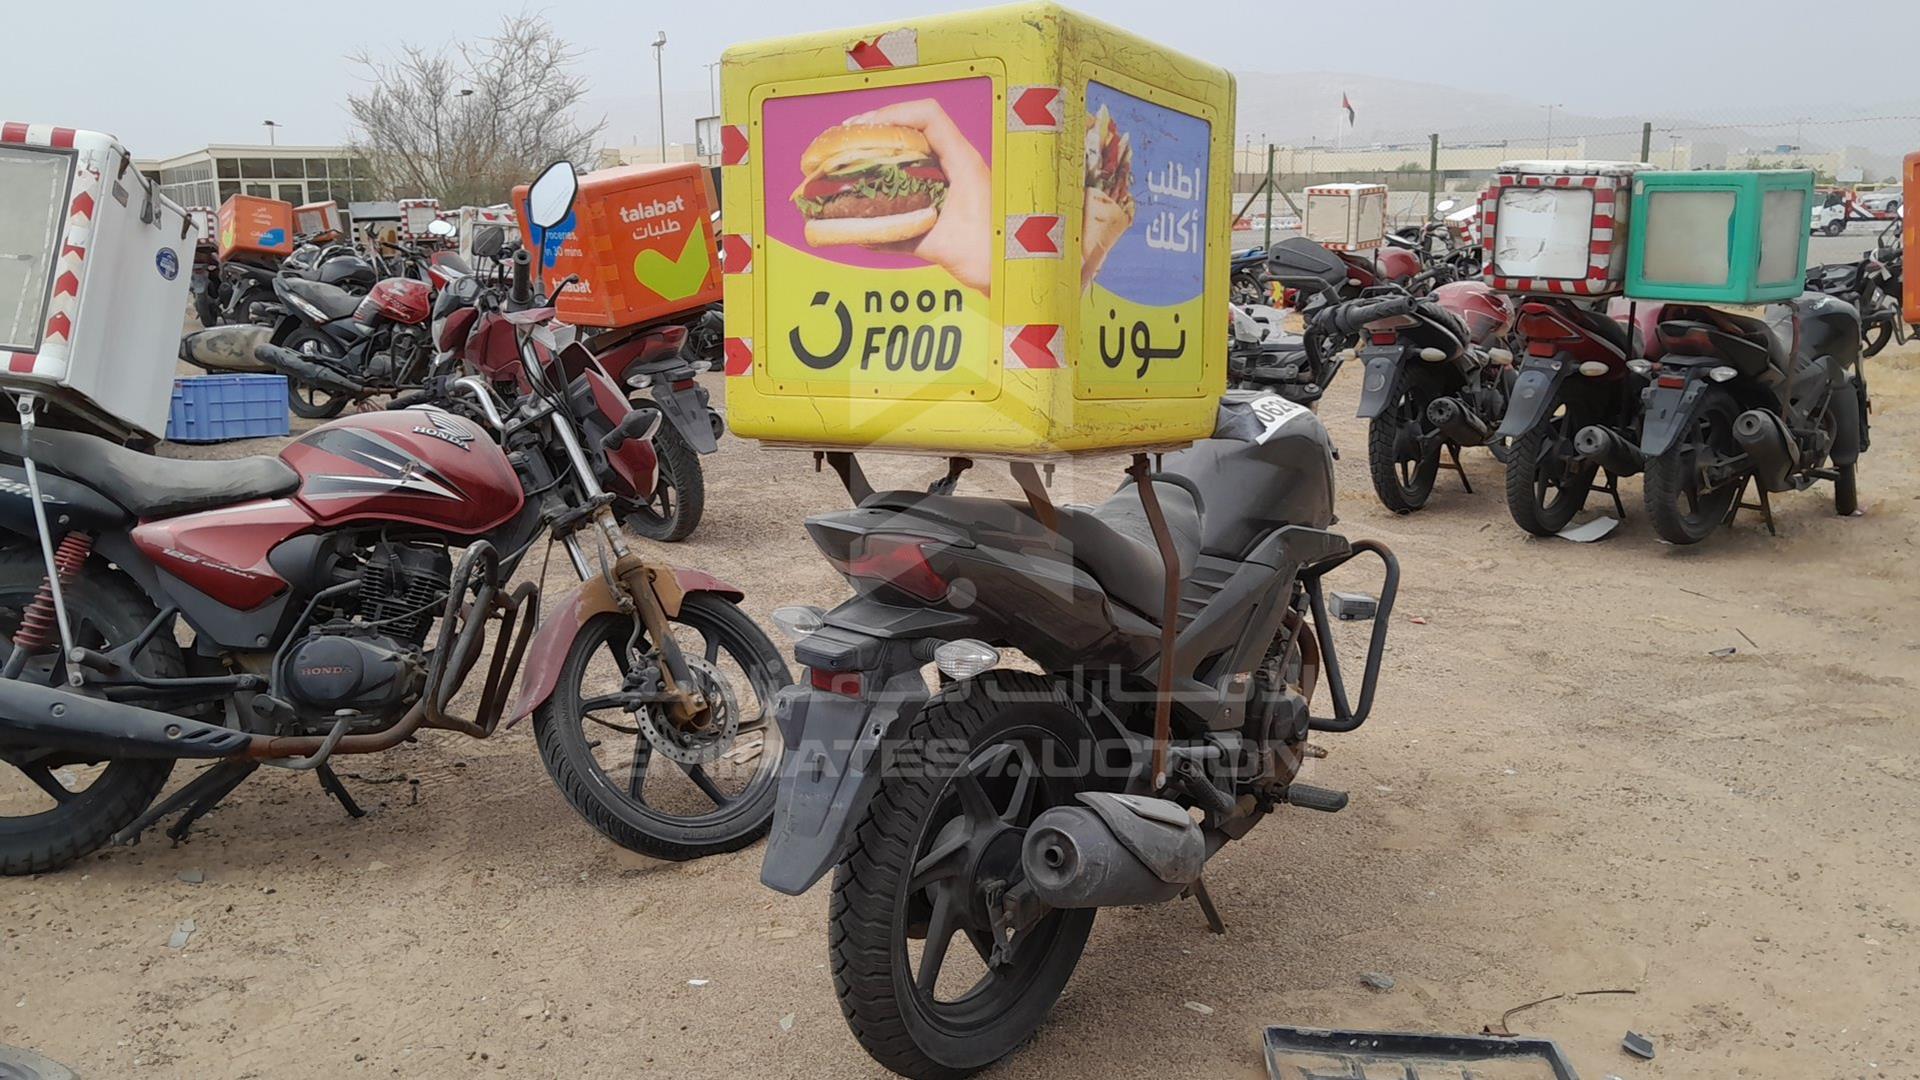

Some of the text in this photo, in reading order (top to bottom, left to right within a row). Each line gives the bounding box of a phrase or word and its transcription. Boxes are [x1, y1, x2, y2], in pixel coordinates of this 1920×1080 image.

[1147, 161, 1201, 202] اطلب
[619, 195, 685, 224] talabat
[632, 218, 681, 241] طلبات
[1146, 208, 1199, 254] أكلك
[864, 286, 964, 314] noon
[859, 324, 963, 373] FOOD
[1099, 308, 1186, 379] نون
[412, 424, 471, 453] HONDA
[302, 666, 353, 676] HONDA
